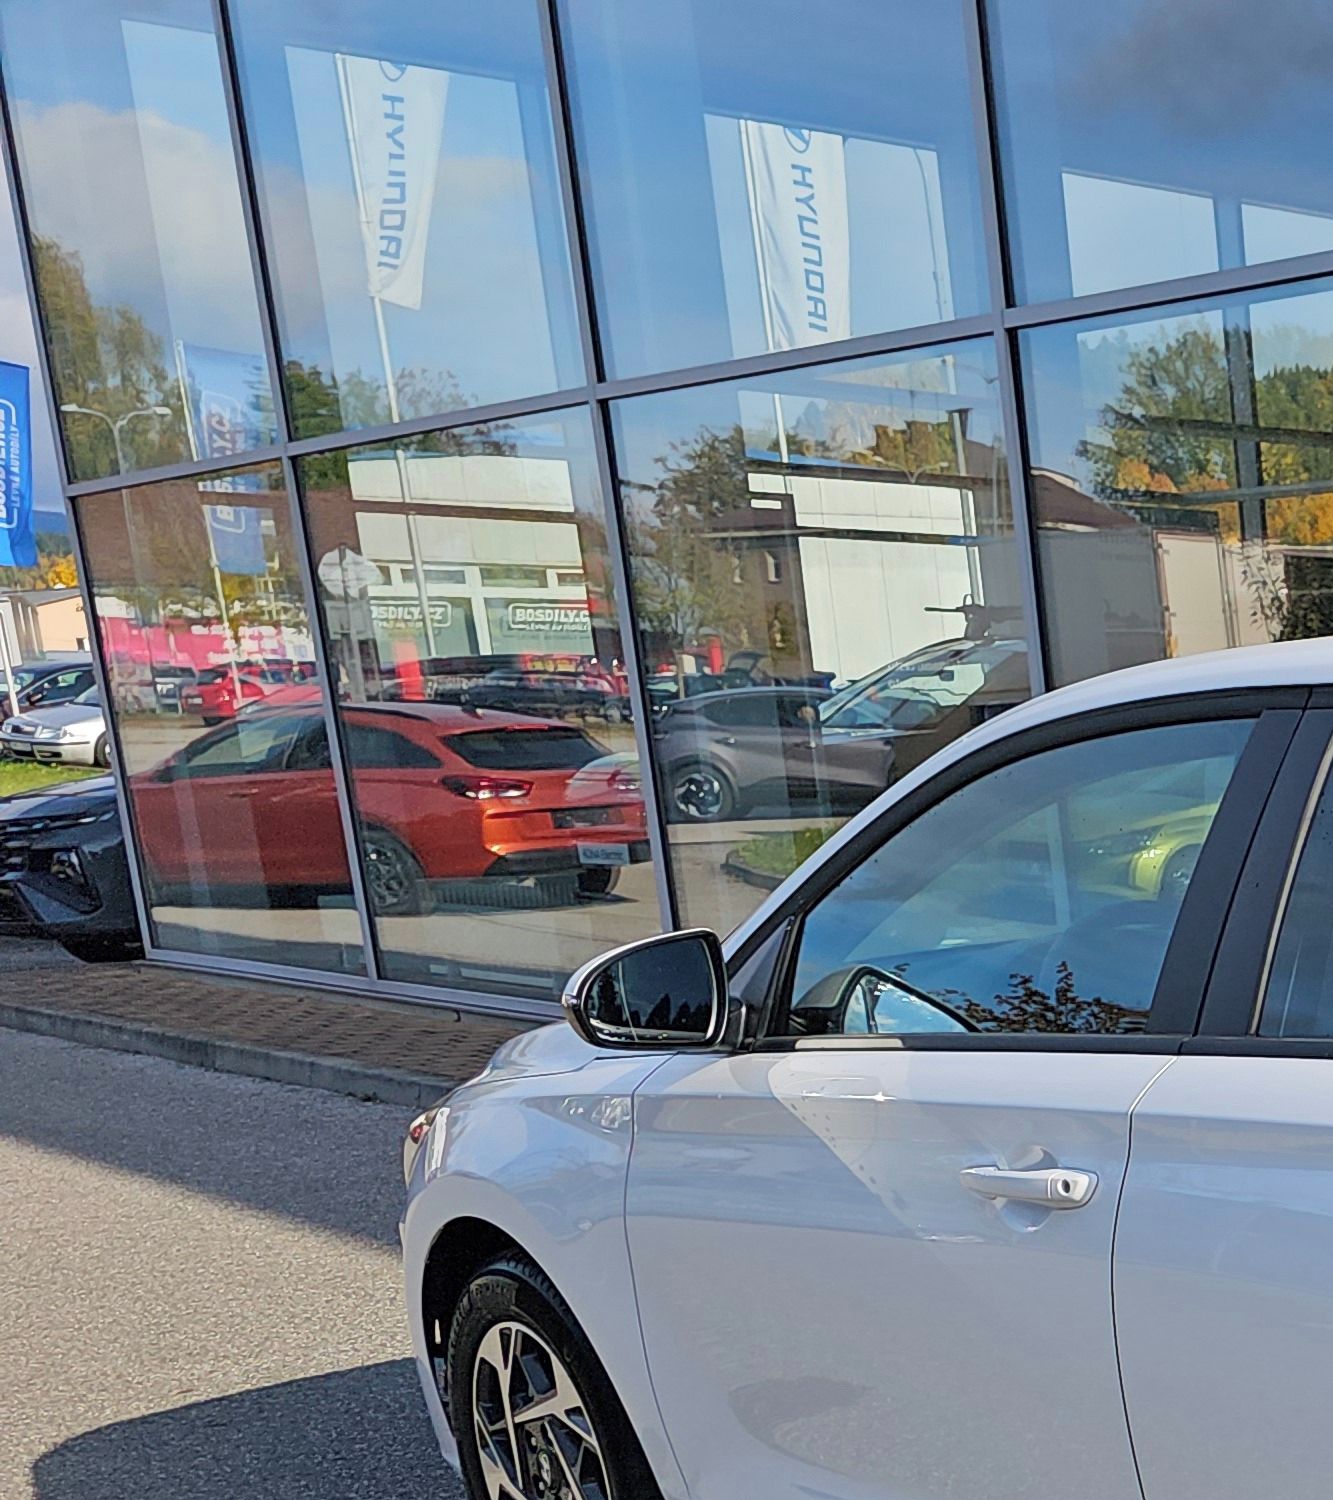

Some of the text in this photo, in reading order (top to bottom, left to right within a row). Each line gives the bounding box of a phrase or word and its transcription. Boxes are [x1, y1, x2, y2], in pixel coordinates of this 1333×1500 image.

[377, 94, 407, 270] HYUNDAI
[791, 163, 828, 333] HYUNDAI
[515, 608, 590, 622] BOSDILY.C
